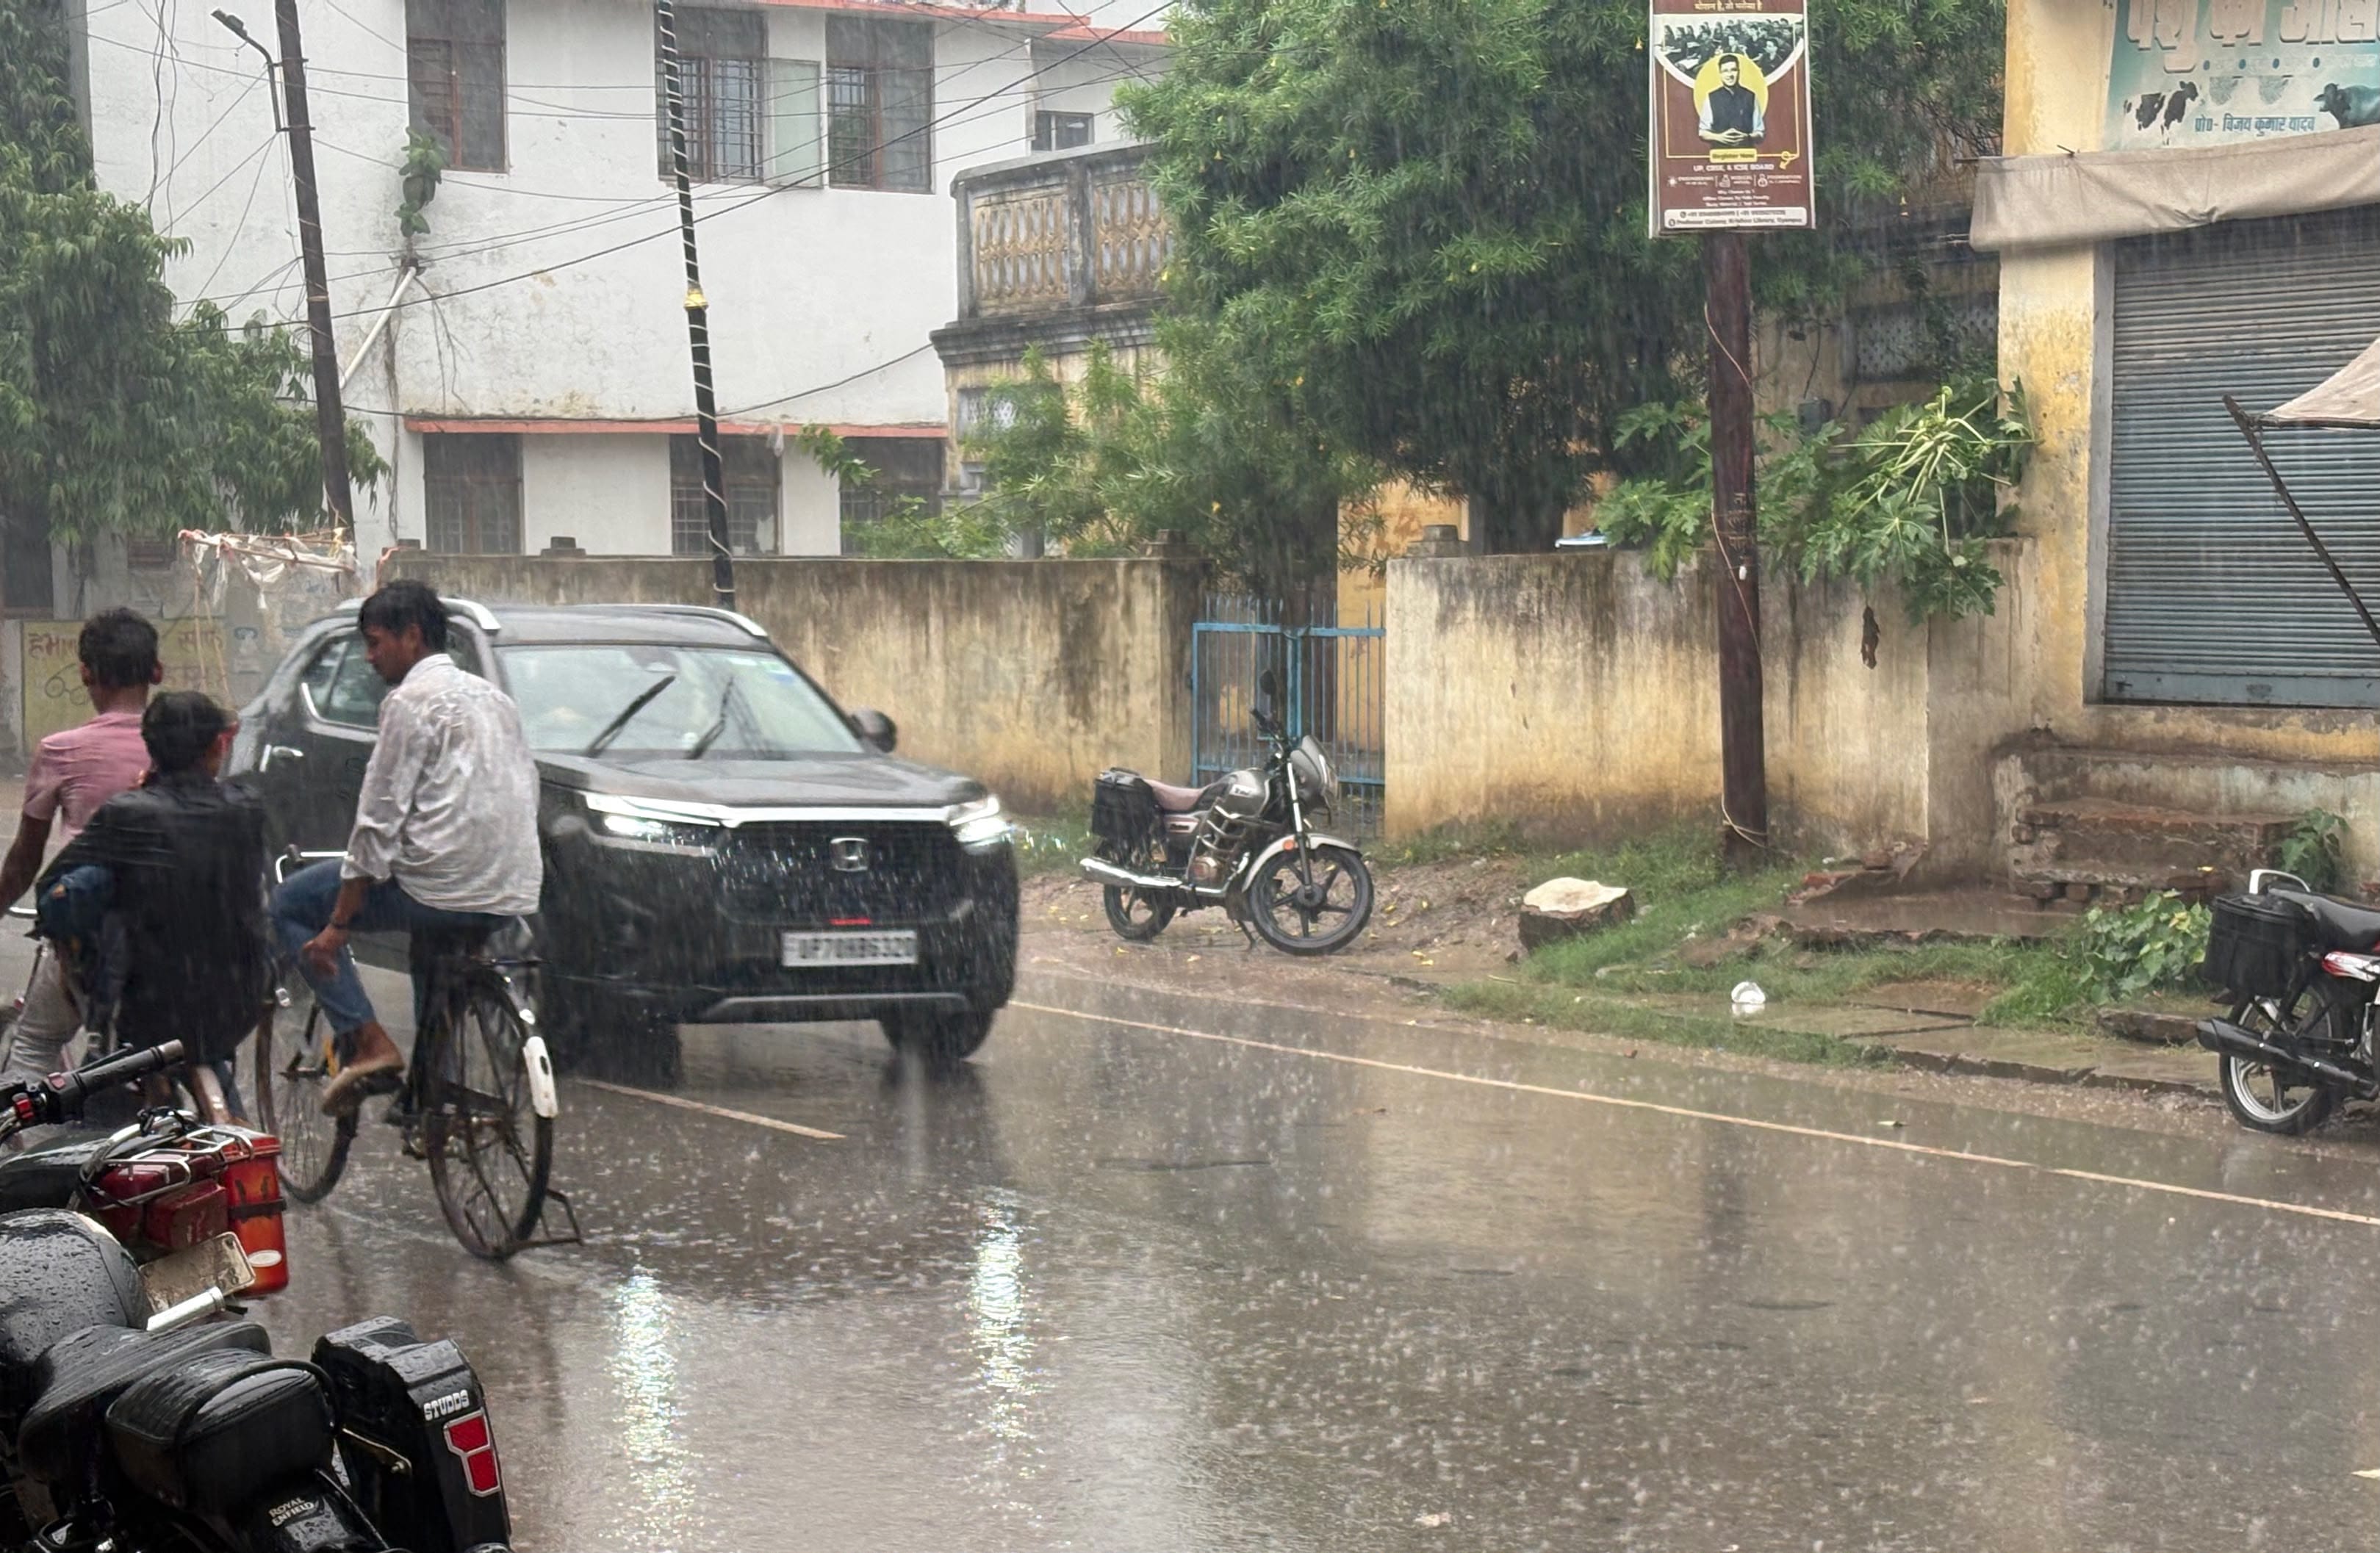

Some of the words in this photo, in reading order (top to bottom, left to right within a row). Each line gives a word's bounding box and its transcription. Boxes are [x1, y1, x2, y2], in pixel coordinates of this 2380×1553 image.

[2222, 112, 2252, 131] विजय
[2254, 115, 2287, 137] कुमार
[2289, 115, 2315, 131] यादव
[423, 1389, 470, 1422] STUDDS
[268, 1497, 306, 1518] ROYAL
[271, 1502, 315, 1527] ENFIELD
